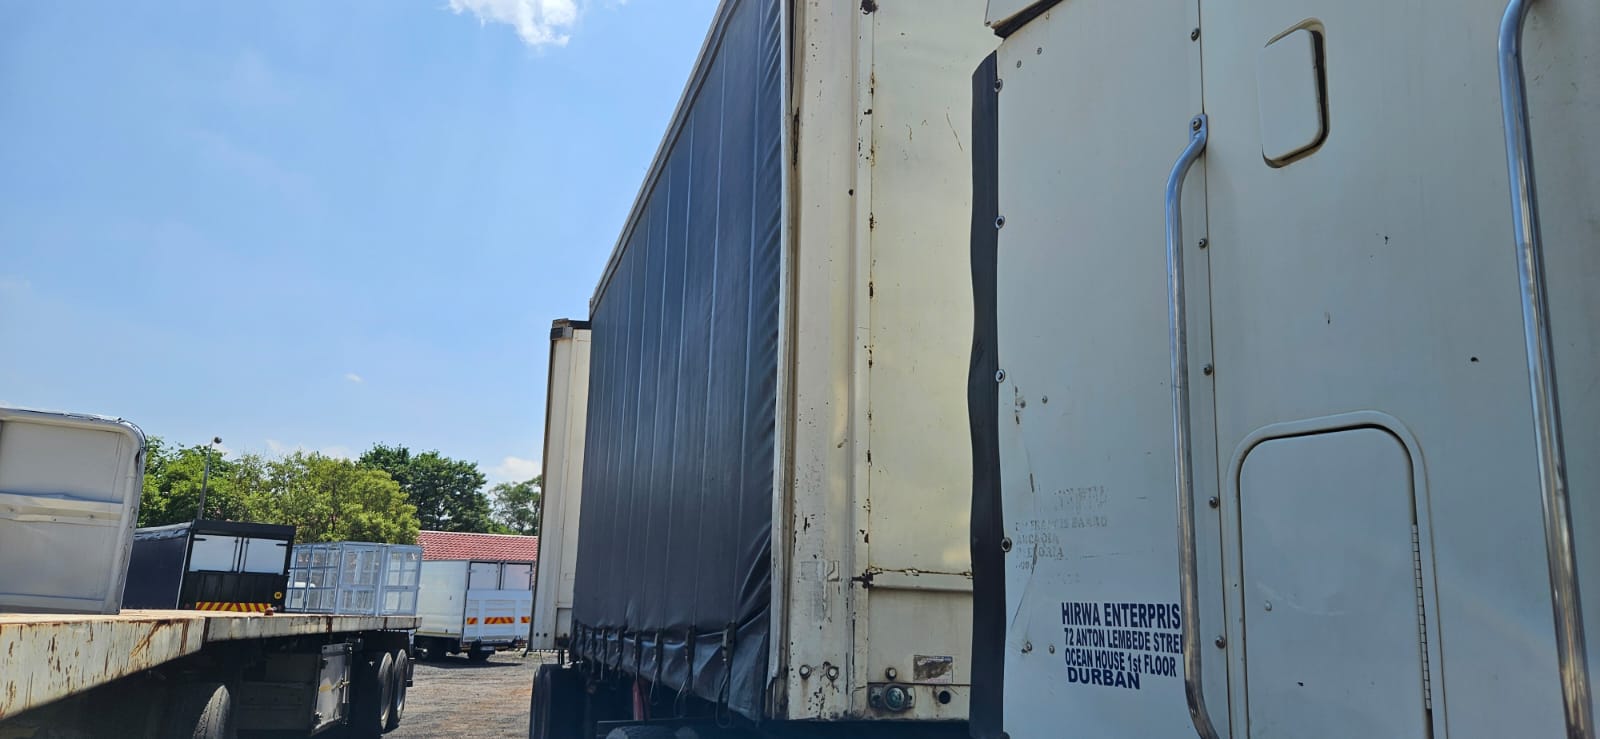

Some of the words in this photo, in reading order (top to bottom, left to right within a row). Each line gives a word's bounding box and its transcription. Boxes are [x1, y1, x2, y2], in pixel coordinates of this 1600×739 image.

[1061, 602, 1101, 626] HIRWA
[1103, 603, 1181, 630] ENTERPRIS
[1064, 628, 1074, 646] 72
[1076, 628, 1105, 648] ANTON
[1107, 629, 1151, 651] LEMBEDE
[1153, 633, 1183, 655] STRE
[1065, 648, 1093, 667] OCEAN
[1095, 649, 1125, 671] HOUSE
[1127, 653, 1142, 673] 1st
[1144, 655, 1177, 677] FLOOR
[1067, 667, 1140, 690] DURBAN
